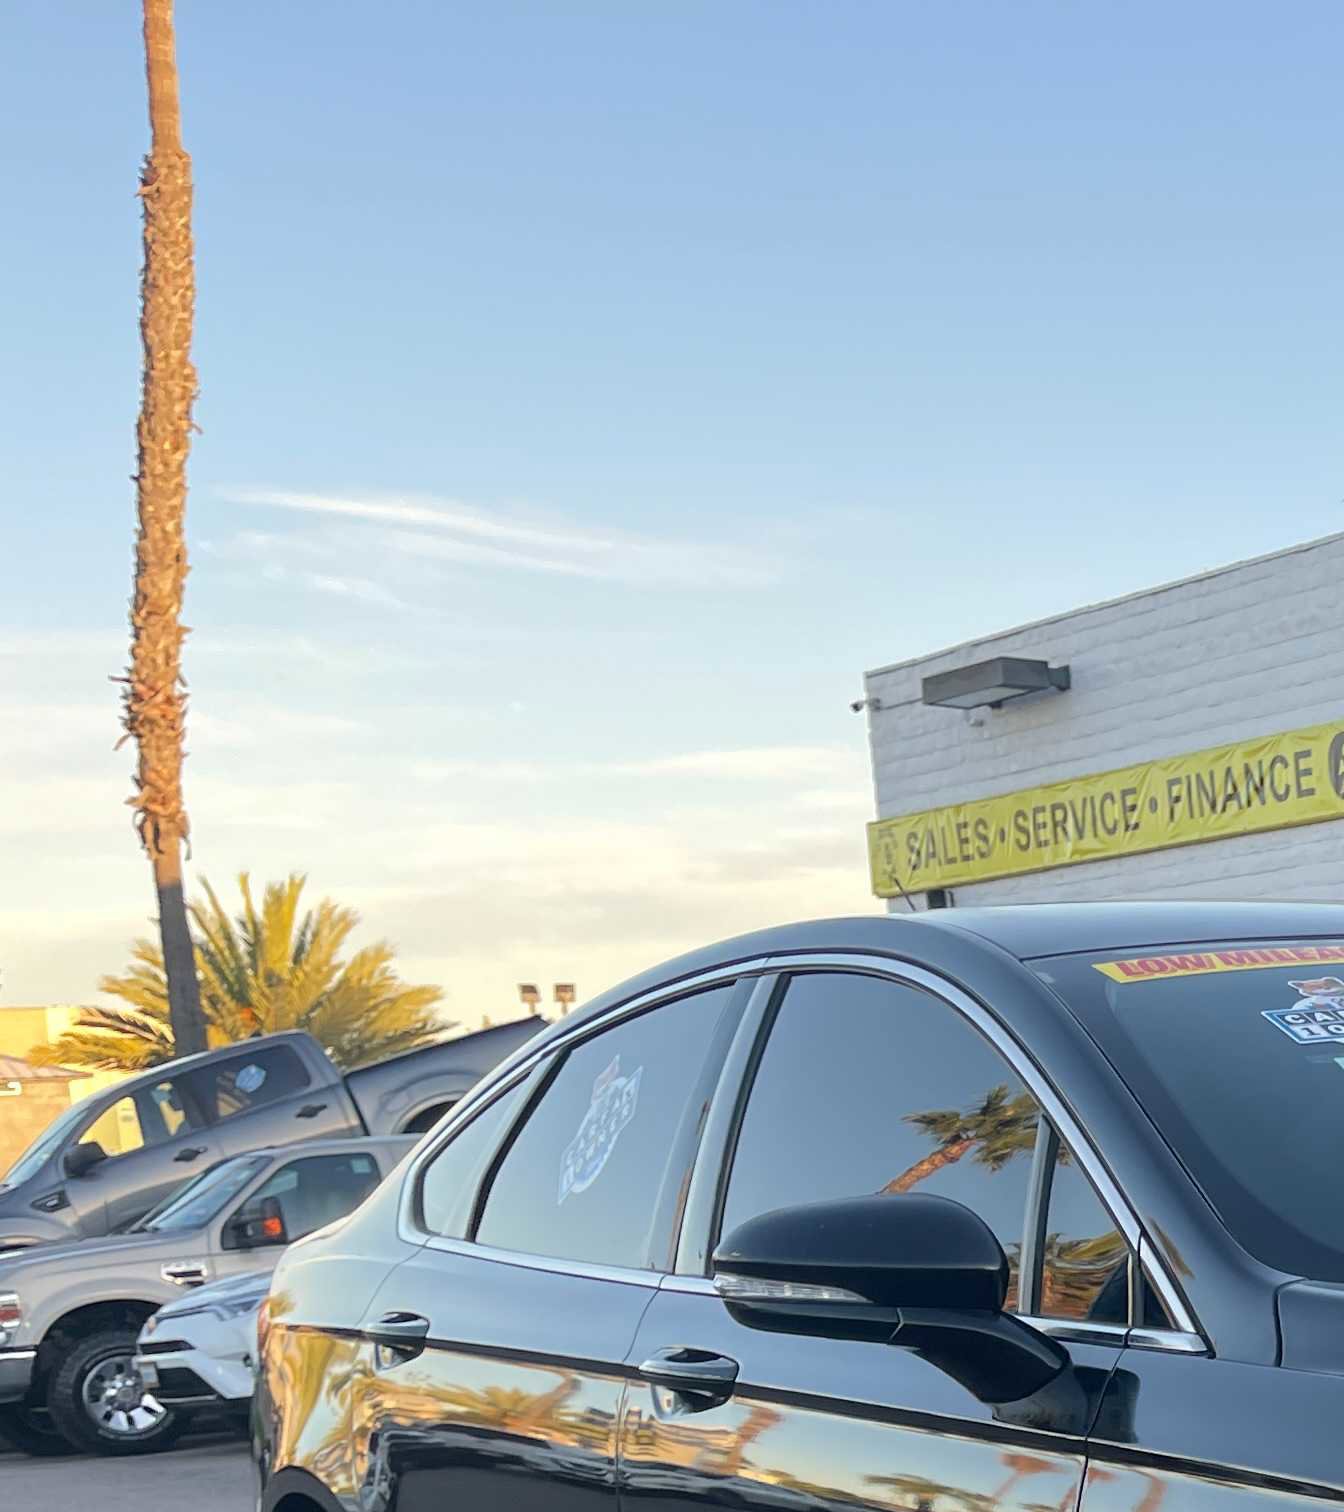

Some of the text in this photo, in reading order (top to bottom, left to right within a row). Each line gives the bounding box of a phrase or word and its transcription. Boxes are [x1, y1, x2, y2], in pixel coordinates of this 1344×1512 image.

[905, 748, 1317, 873] SALES SERVICE FINANCE
[1116, 953, 1216, 976] LOW
